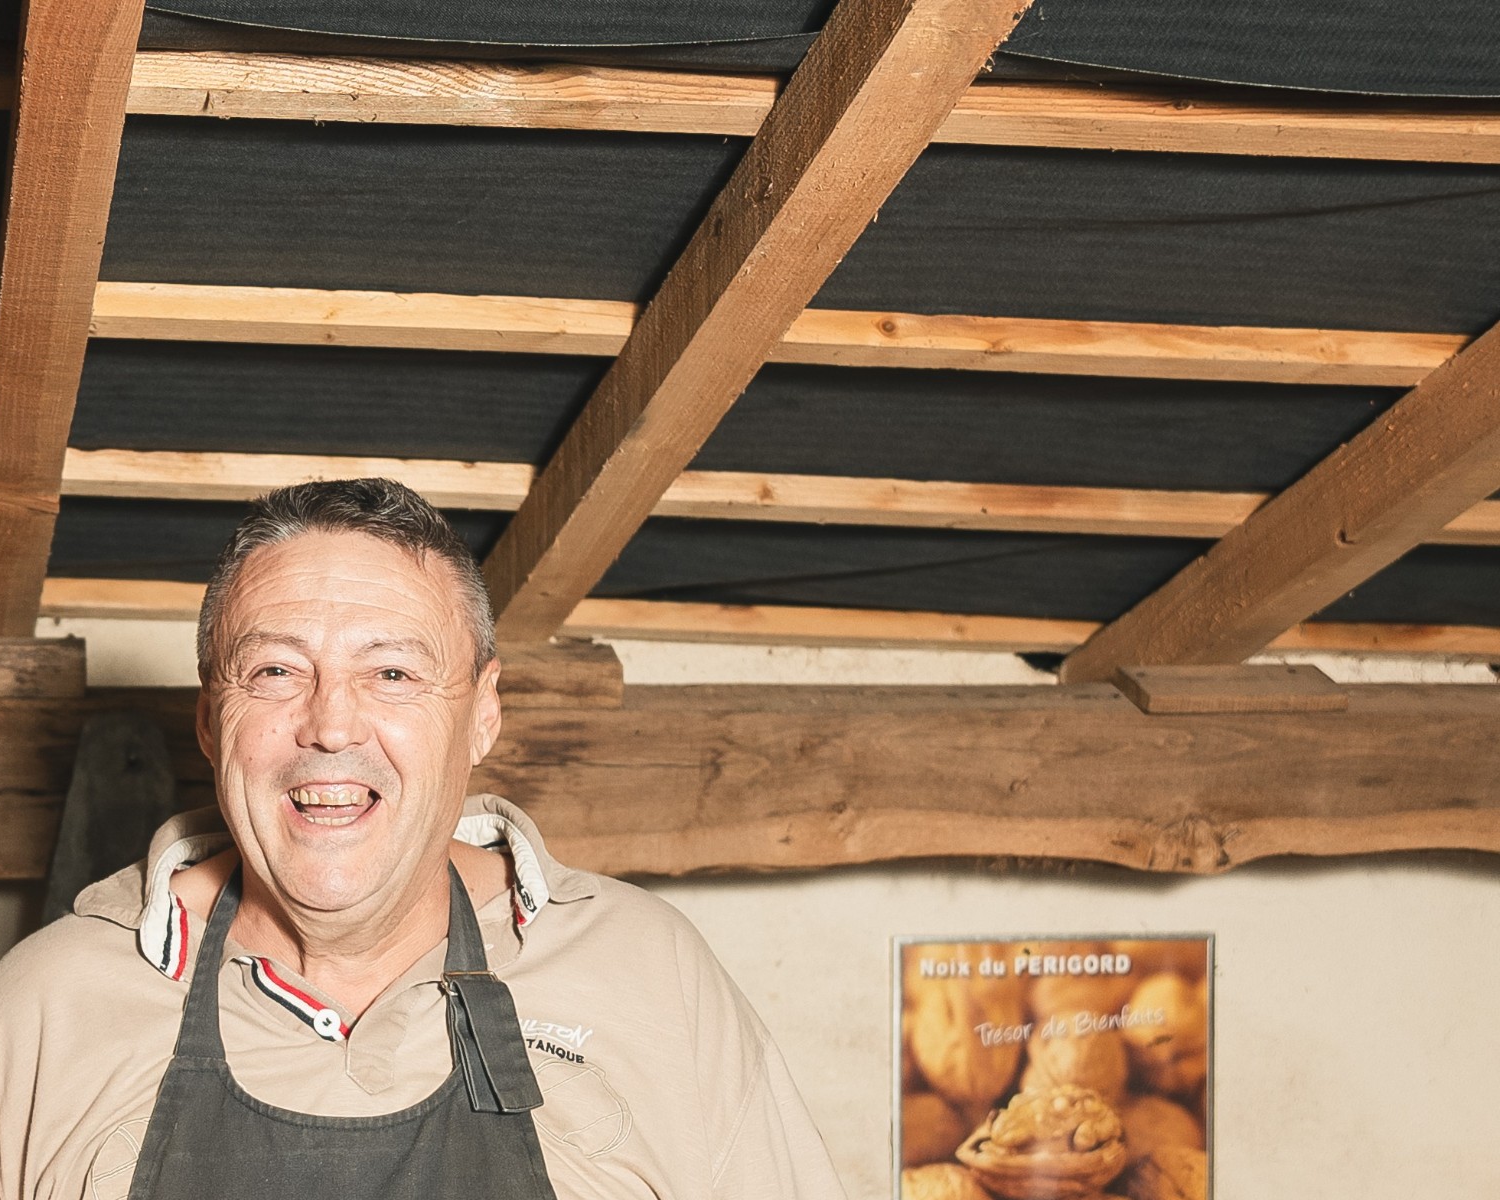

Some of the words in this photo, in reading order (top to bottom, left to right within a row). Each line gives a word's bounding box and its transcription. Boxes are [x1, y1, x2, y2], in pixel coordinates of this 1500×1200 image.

[919, 957, 970, 977] Noix
[978, 957, 1006, 976] du
[1014, 954, 1132, 976] PERIGORD
[1041, 1014, 1067, 1040] de
[1071, 1003, 1166, 1036] Bienfaits
[526, 1038, 585, 1064] TANQUE
